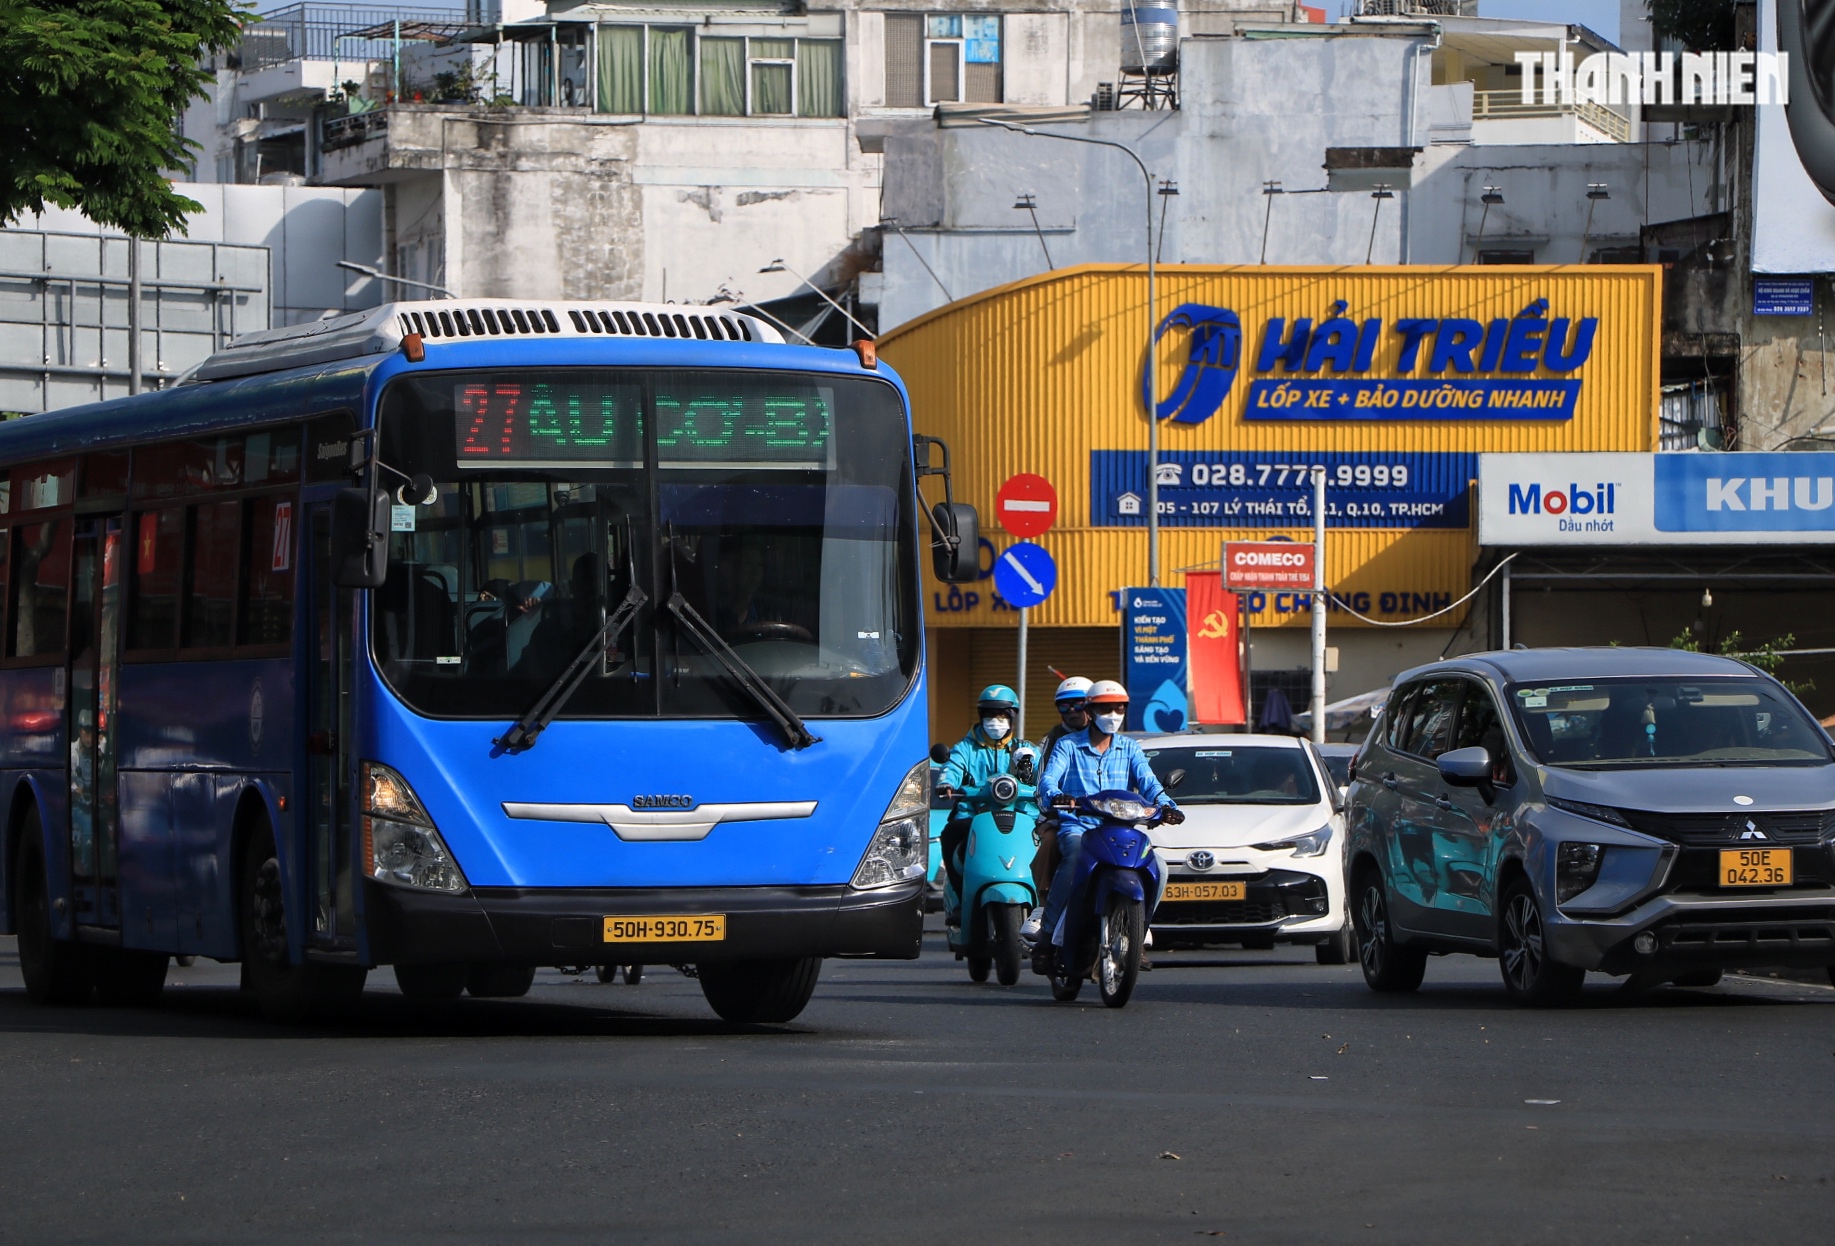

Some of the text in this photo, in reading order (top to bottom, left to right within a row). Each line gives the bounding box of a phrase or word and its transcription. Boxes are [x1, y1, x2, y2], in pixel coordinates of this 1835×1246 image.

[1257, 300, 1382, 372] HẢI
[1257, 381, 1566, 408] LỐP XE + BẢO DƯỠNG NHANH
[463, 383, 521, 453] 27
[1508, 483, 1615, 515] Mobil
[1706, 477, 1833, 511] KHU
[1157, 501, 1176, 515] 05
[1192, 501, 1219, 515] 107
[1224, 497, 1242, 515] LÝ
[1246, 498, 1283, 515] THÁI
[1389, 503, 1444, 516] TP.HCM
[1559, 516, 1614, 532] Dầu nhớt
[272, 506, 291, 568] 27
[1234, 552, 1305, 567] COMECO
[1379, 591, 1451, 613] ĐINH
[633, 794, 693, 808] SAMCO
[1740, 851, 1771, 866] 50E
[1727, 868, 1784, 883] 042.36
[1165, 885, 1238, 898] 63H-057.03
[613, 920, 715, 938] 50H-930.75
